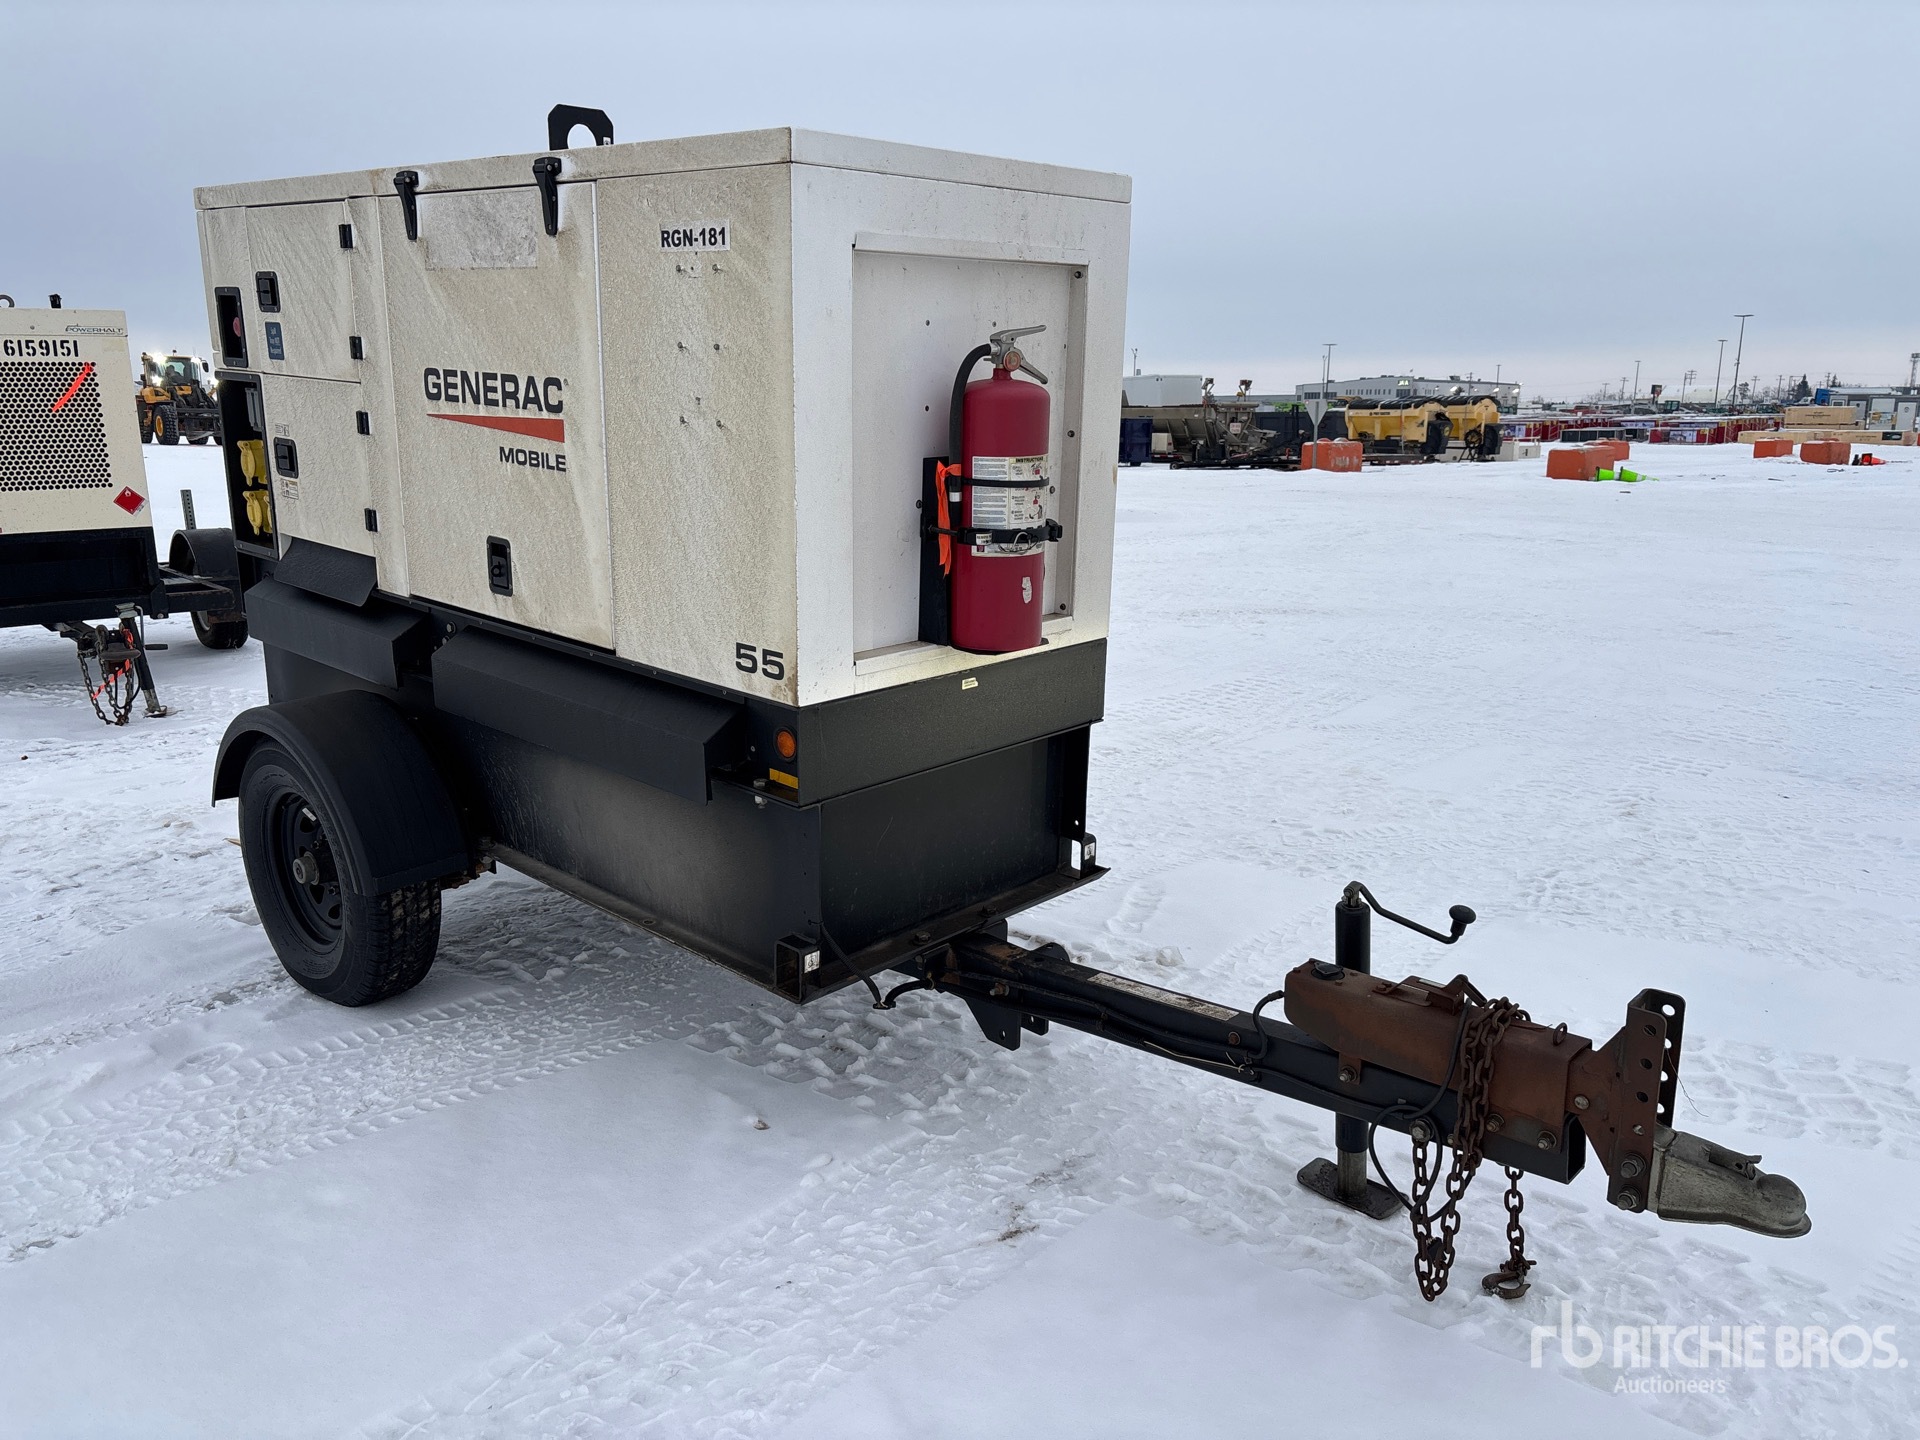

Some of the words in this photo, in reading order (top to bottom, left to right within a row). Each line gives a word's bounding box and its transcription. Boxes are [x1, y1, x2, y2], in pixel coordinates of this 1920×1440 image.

[661, 227, 725, 247] RGN-181
[4, 339, 79, 357] 6159151
[424, 368, 563, 413] GENERAC
[499, 447, 567, 472] MOBILE
[736, 642, 785, 680] 55
